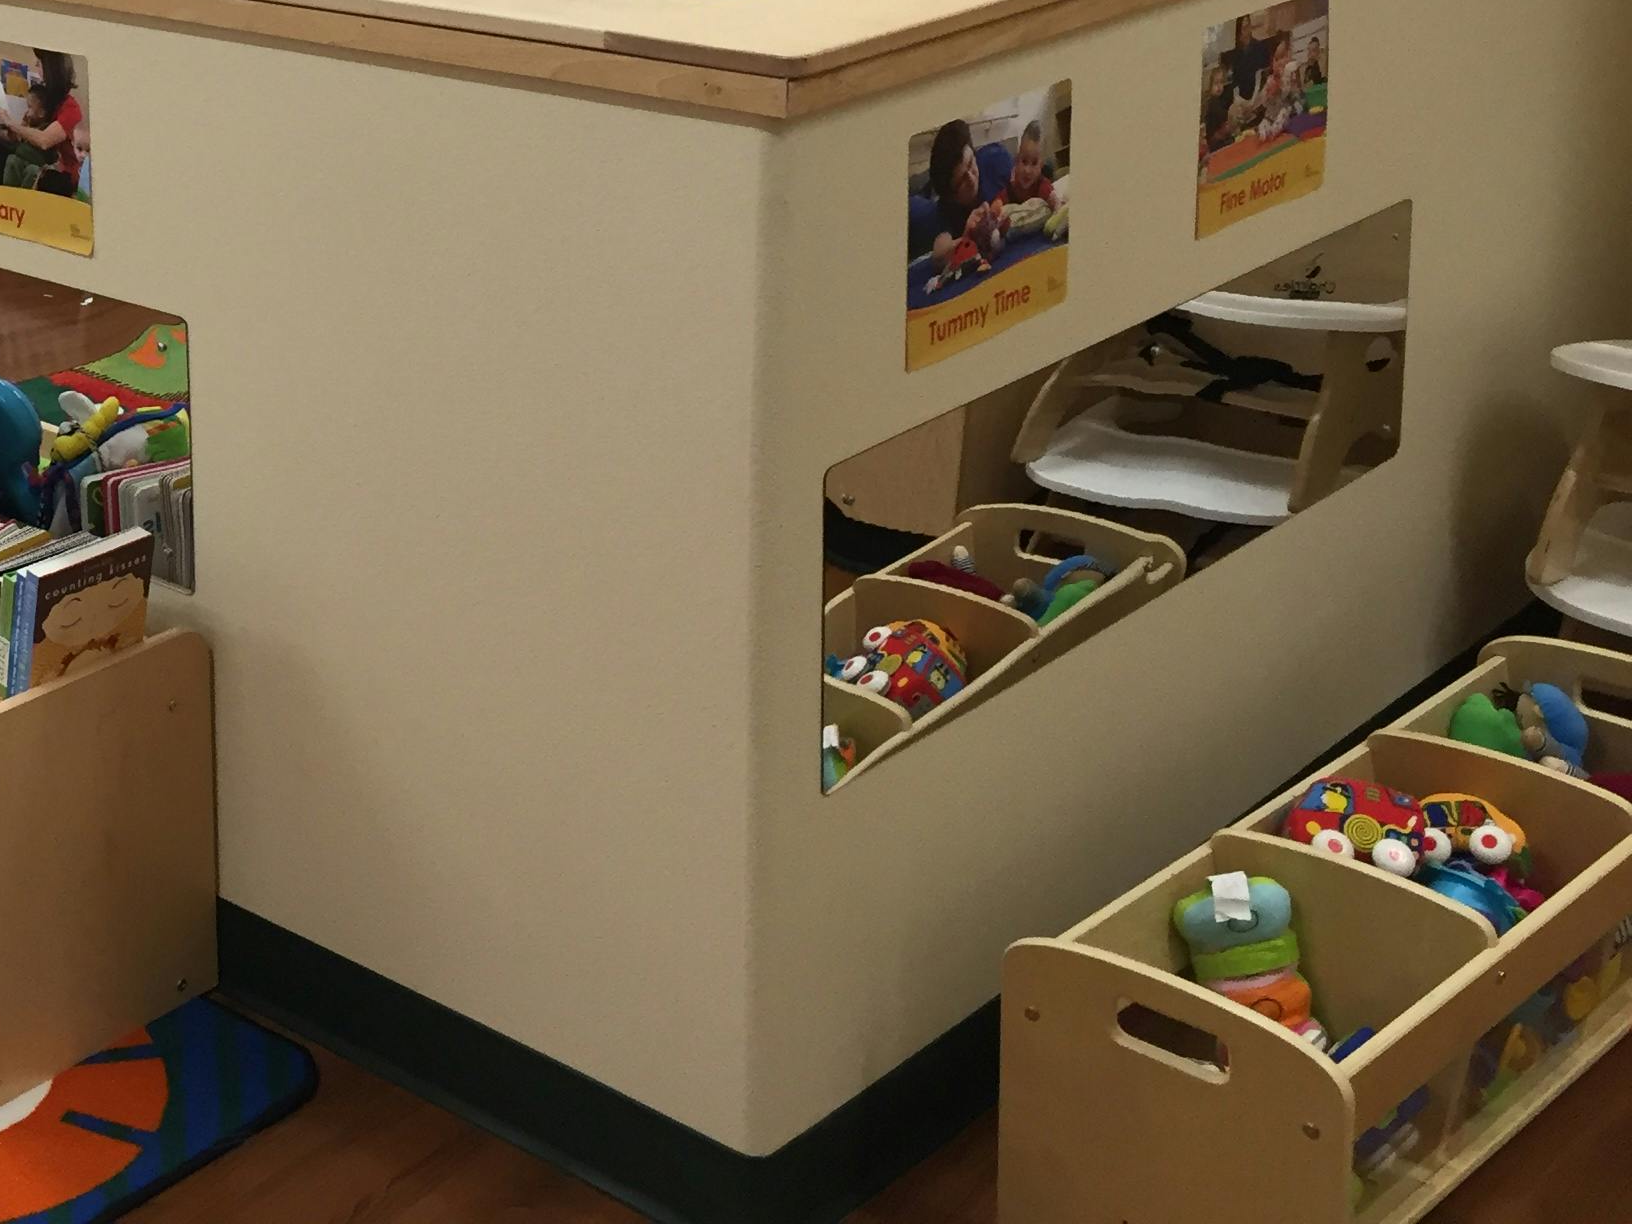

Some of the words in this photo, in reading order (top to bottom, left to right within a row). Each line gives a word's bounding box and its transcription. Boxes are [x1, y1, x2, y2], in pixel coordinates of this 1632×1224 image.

[1219, 185, 1246, 214] Fine
[1249, 171, 1287, 200] Motor
[928, 301, 990, 345] Tummy
[992, 282, 1031, 316] Time
[44, 571, 103, 600] counting
[109, 554, 148, 575] kisses
